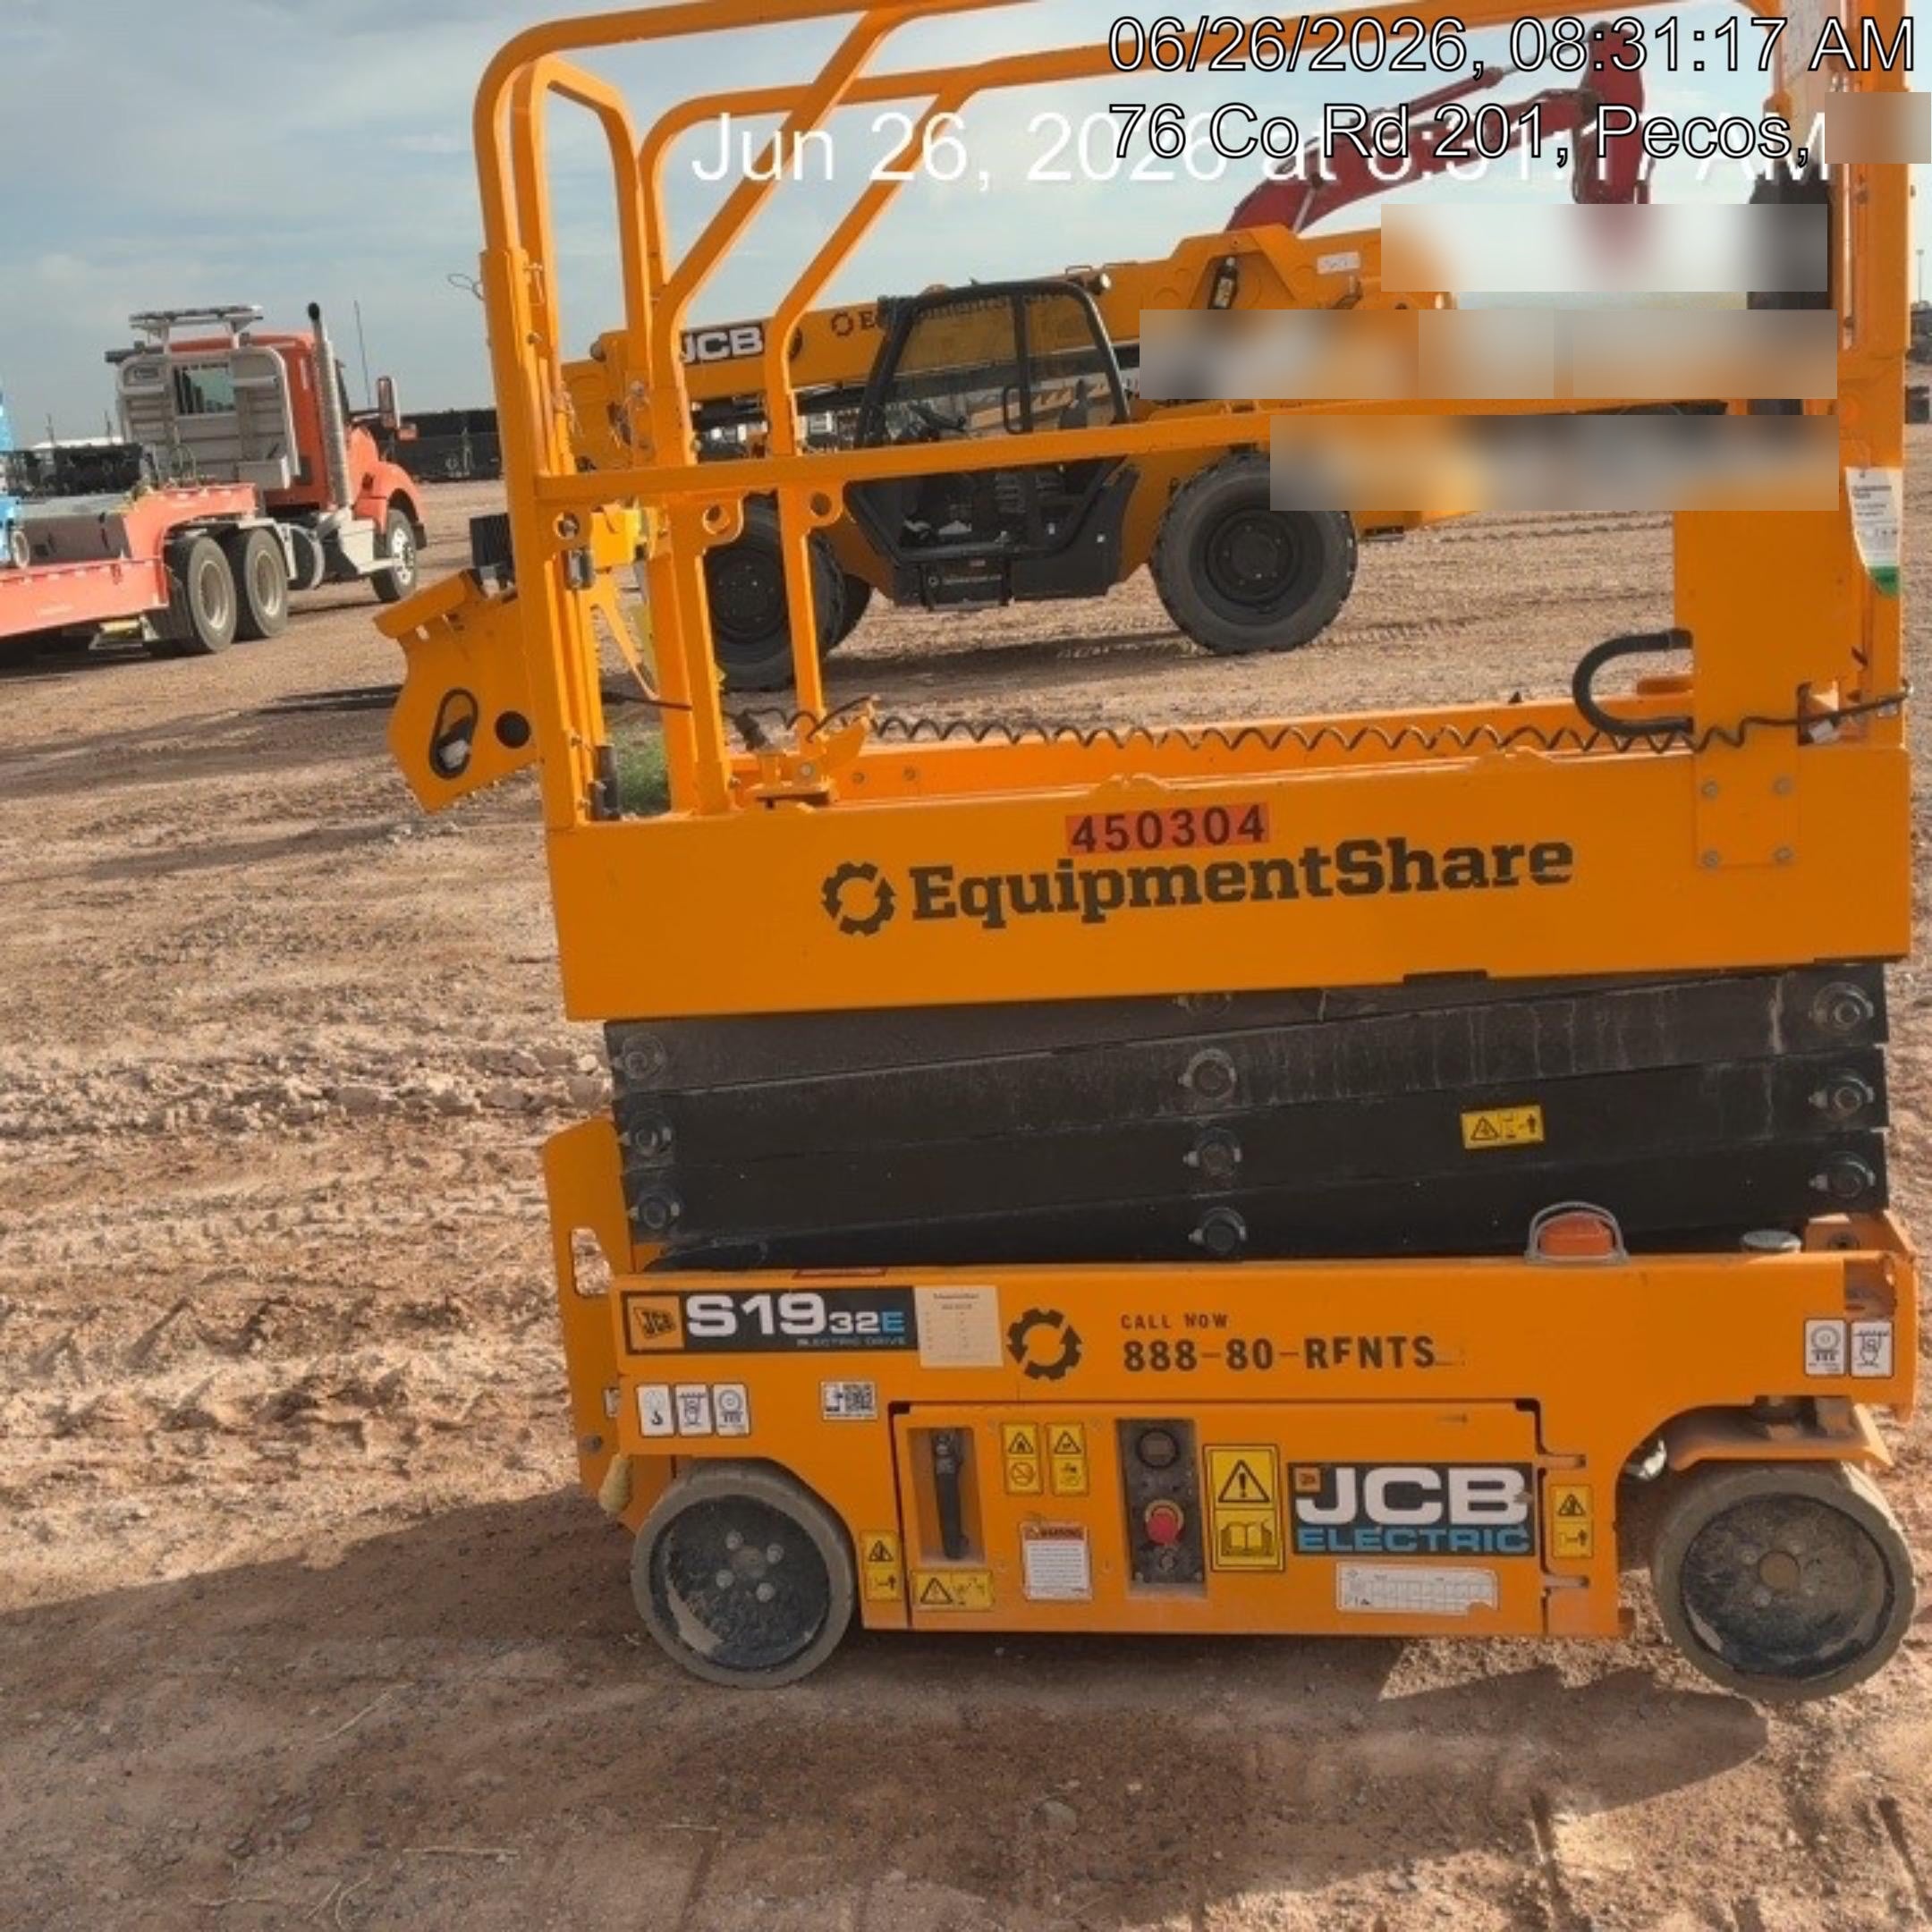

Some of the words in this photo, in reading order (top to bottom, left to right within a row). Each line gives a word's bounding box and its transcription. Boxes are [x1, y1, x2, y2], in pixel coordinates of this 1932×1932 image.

[680, 327, 764, 363] JCB
[1071, 804, 1265, 852] 450304
[910, 837, 1574, 929] EquipmentShare
[1120, 1314, 1172, 1330] CALL
[1183, 1312, 1229, 1329] NOW
[1295, 1467, 1529, 1525] JCB
[1298, 1527, 1530, 1553] ELECTRIC
